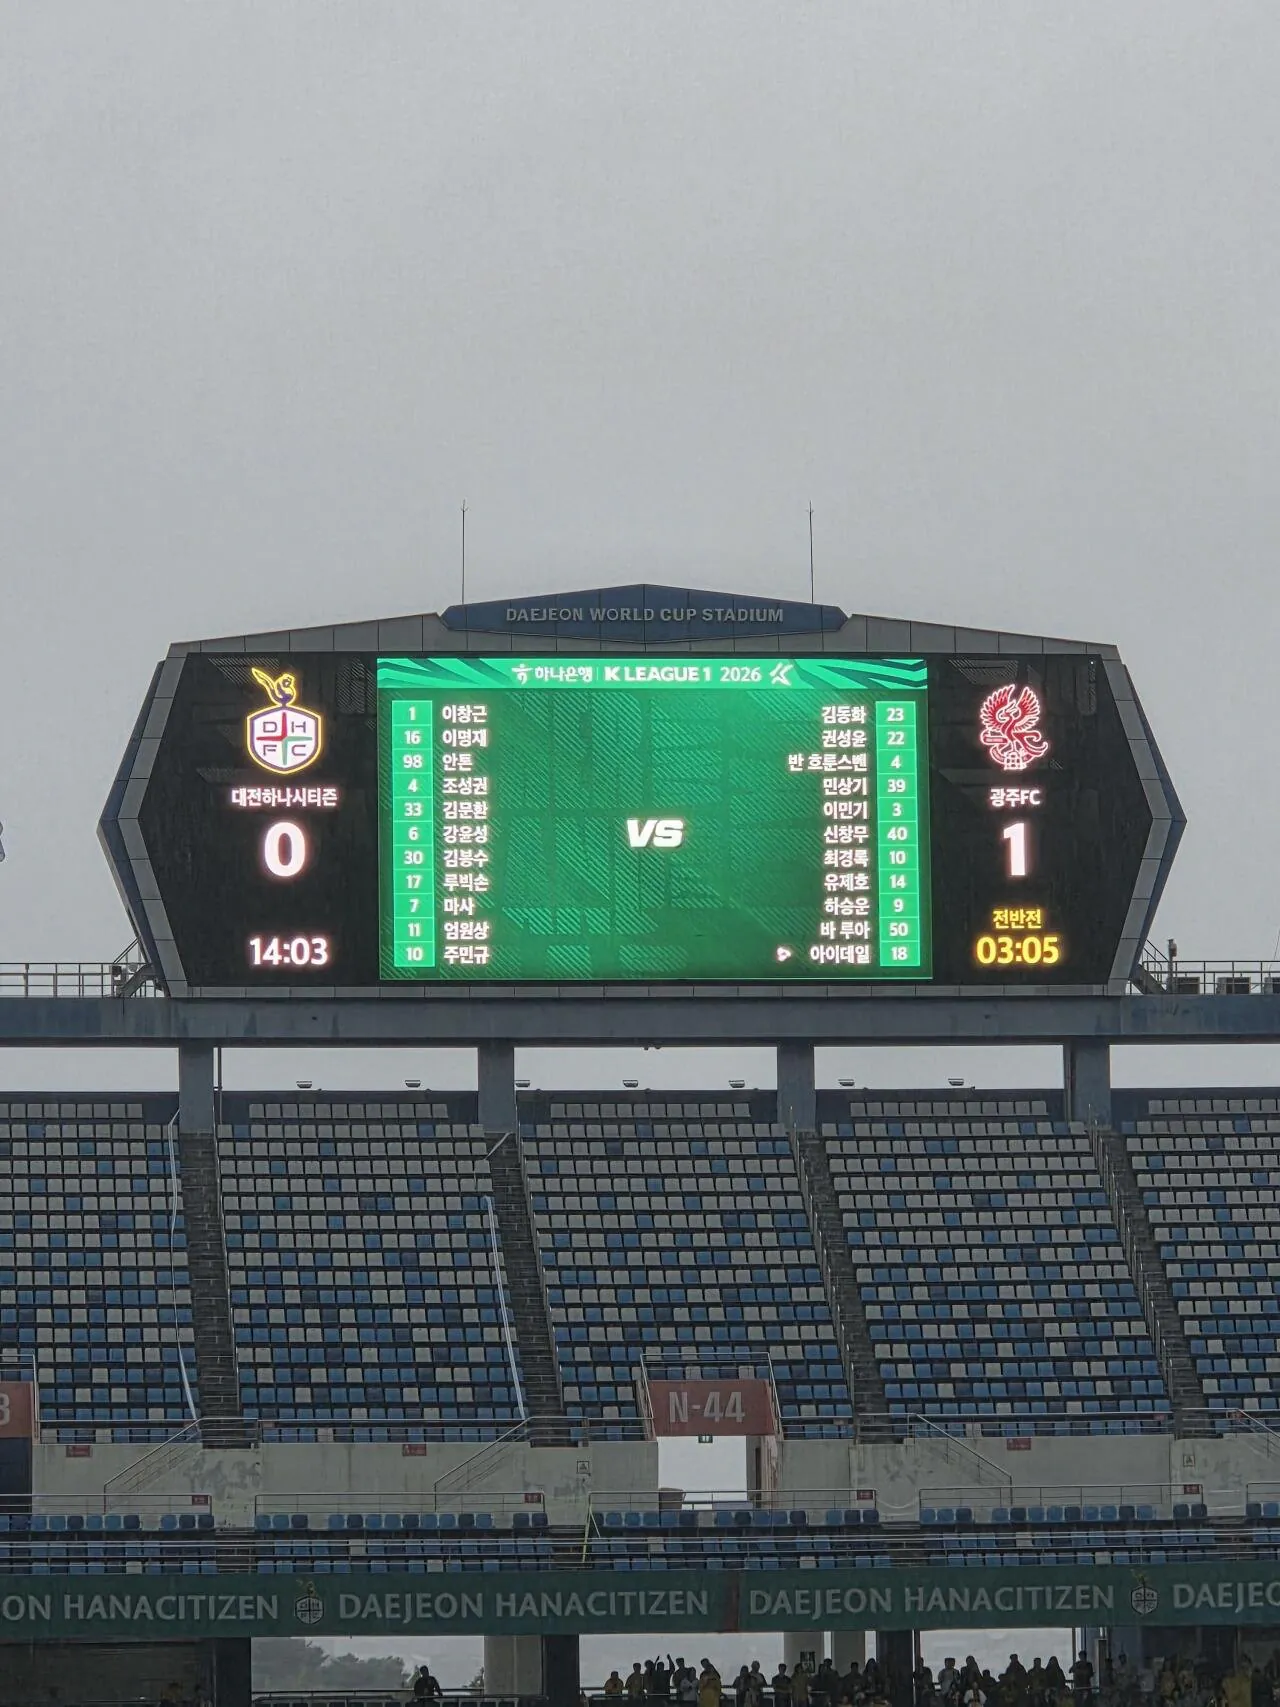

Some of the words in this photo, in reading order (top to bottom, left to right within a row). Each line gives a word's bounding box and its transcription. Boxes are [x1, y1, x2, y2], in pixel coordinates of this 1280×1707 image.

[506, 608, 583, 622] DAEJEON
[591, 608, 655, 621] WORLD
[660, 608, 697, 621] CUP
[702, 608, 784, 622] STADIUM
[534, 665, 593, 683] 하나은행
[603, 666, 620, 682] K
[624, 666, 699, 682] LEAGUE
[703, 666, 712, 682] 1
[719, 666, 762, 682] 2026
[409, 707, 416, 721] 1
[441, 704, 488, 724] 이창근
[887, 707, 904, 722] 23
[405, 730, 421, 745] 16
[441, 728, 489, 748] 이명재
[821, 728, 868, 749] 권성윤
[887, 731, 905, 745] 22
[403, 754, 423, 769] 98
[442, 752, 474, 772] 안톤
[788, 752, 805, 772] 반
[891, 755, 901, 769] 4
[408, 779, 418, 793] 4
[441, 776, 489, 796] 조성권
[822, 776, 868, 796] 민상기
[888, 779, 906, 793] 39
[231, 787, 338, 807] 대전하나시티즌
[990, 788, 1041, 807] 광주FC
[405, 802, 422, 817] 33
[442, 799, 489, 820] 김문환
[822, 800, 868, 820] 이민기
[893, 803, 902, 817] 3
[408, 826, 419, 841] 6
[442, 824, 490, 844] 강윤성
[626, 819, 684, 848] VS
[823, 824, 870, 844] 신창무
[887, 827, 908, 841] 40
[264, 821, 306, 877] 0
[404, 850, 423, 865] 30
[443, 848, 489, 868] 김봉수
[823, 848, 870, 868] 최경록
[889, 850, 906, 865] 10
[1003, 822, 1026, 876] 1
[407, 875, 421, 889] 17
[442, 872, 490, 892] 루빅손
[823, 872, 870, 892] 유제호
[890, 875, 906, 888] 14
[410, 898, 419, 913] 7
[443, 896, 476, 916] 마사
[823, 896, 871, 916] 하승운
[893, 898, 904, 913] 9
[992, 908, 1042, 929] 전반전
[408, 923, 421, 937] 11
[443, 920, 491, 941] 엄원상
[820, 920, 836, 940] 바
[839, 921, 871, 940] 루아
[889, 922, 909, 937] 50
[249, 938, 329, 965] 14:03
[407, 947, 423, 961] 10
[443, 945, 491, 965] 주민규
[809, 944, 870, 964] 아이데일
[891, 946, 908, 961] 18
[976, 936, 1060, 964] 03:05
[669, 1391, 745, 1423] N-44
[2, 1594, 51, 1620] ON
[63, 1593, 278, 1620] HANACITIZEN
[339, 1592, 481, 1624] DAEJEON
[496, 1590, 709, 1618] HANACITIZEN
[749, 1587, 892, 1620] DAEJEON
[904, 1584, 1114, 1612] HANACITIZEN
